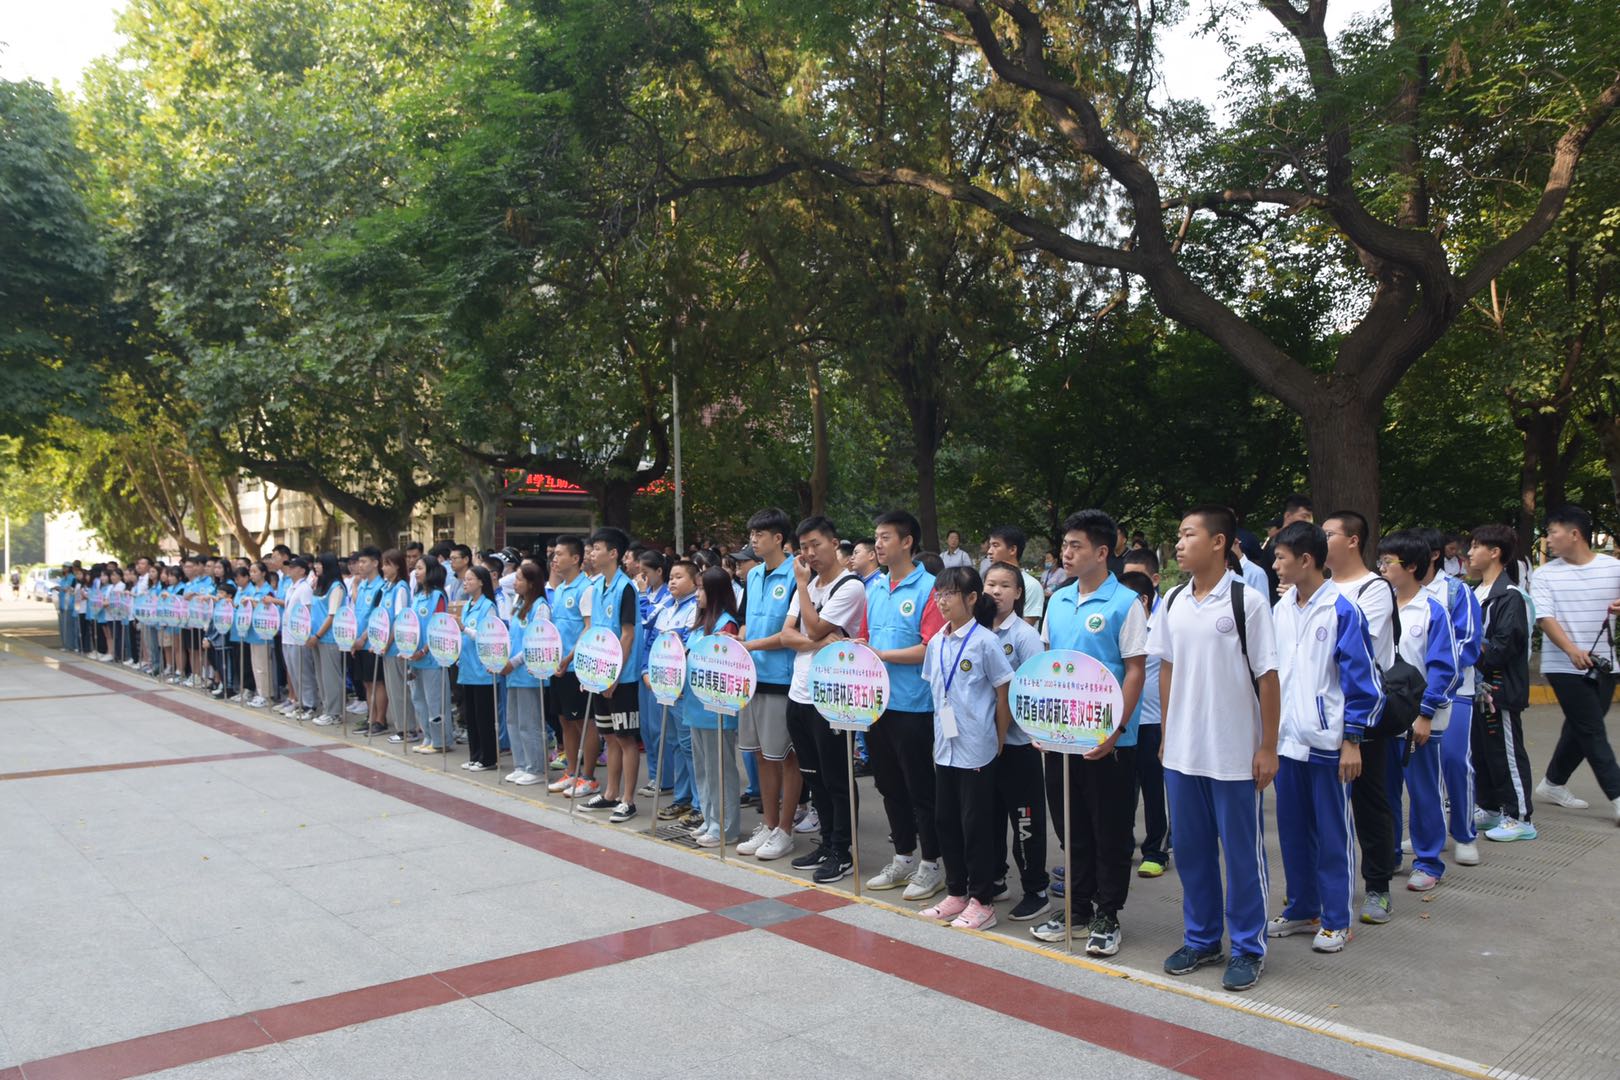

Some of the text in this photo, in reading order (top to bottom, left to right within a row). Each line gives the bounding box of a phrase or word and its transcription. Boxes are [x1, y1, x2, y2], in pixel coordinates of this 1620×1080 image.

[690, 667, 751, 698] 西安博爱国际学校
[813, 680, 884, 710] 西安市碑林区铁五小学
[1017, 806, 1033, 841] FILA
